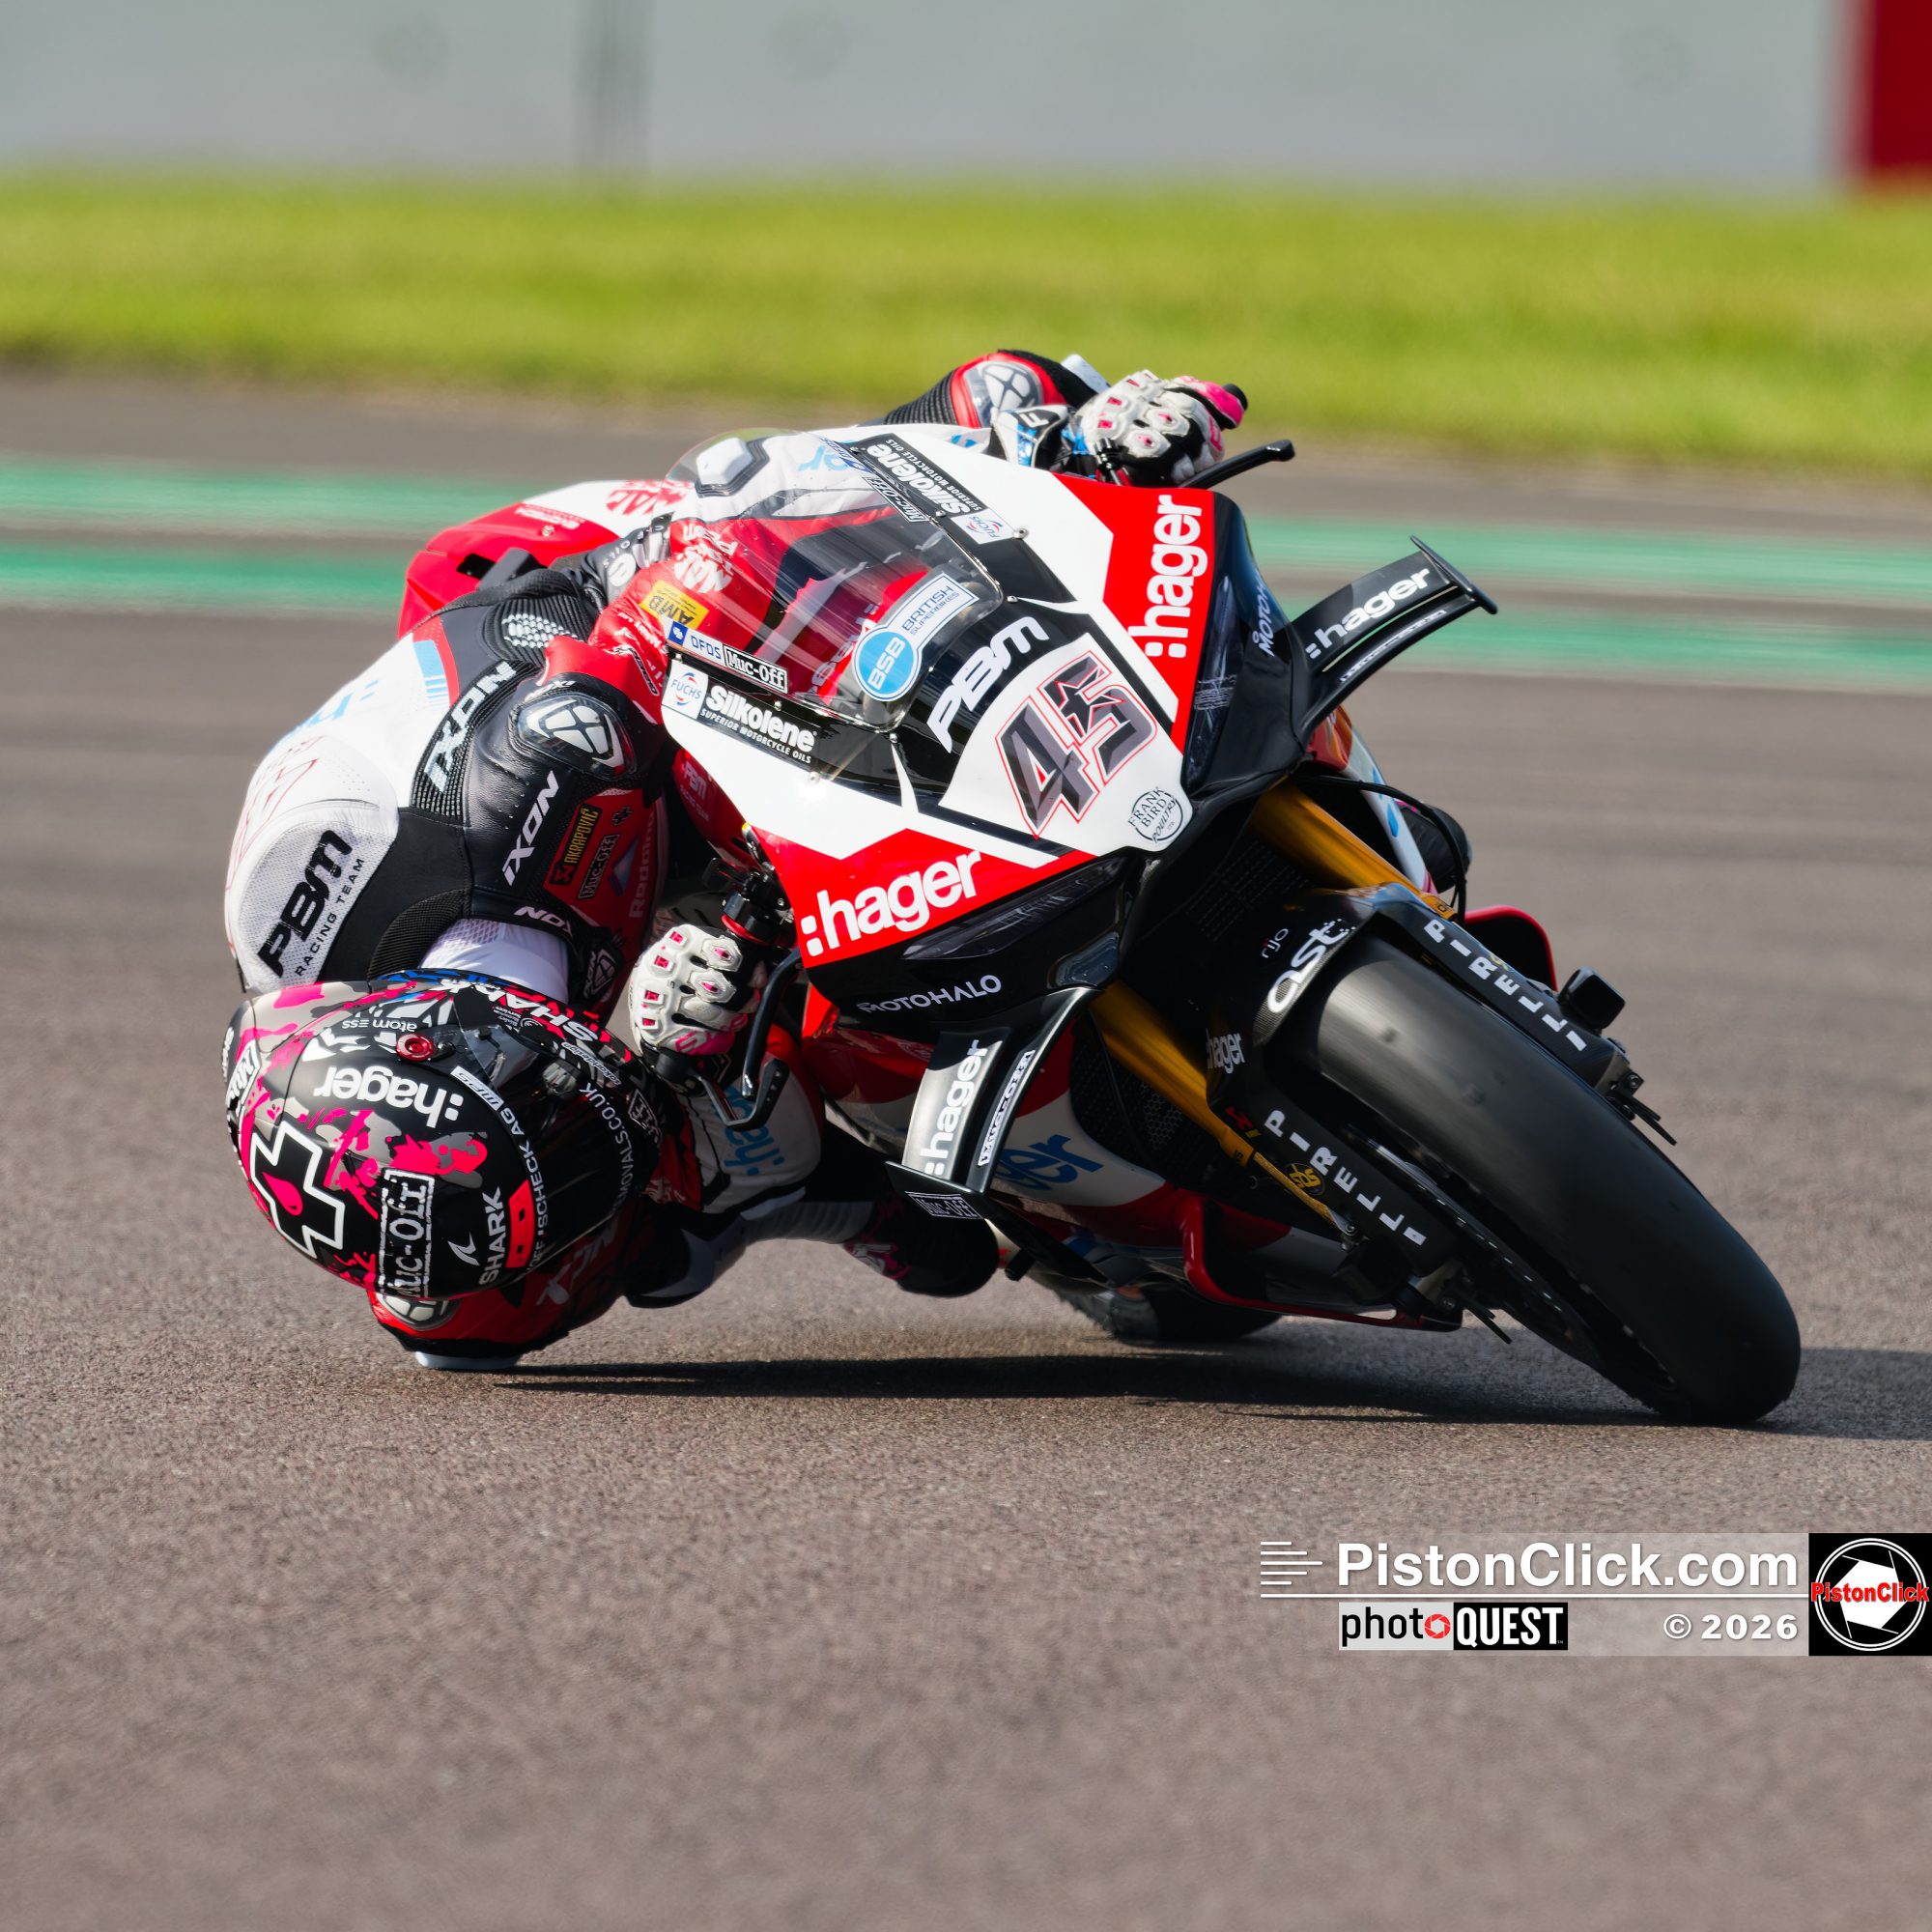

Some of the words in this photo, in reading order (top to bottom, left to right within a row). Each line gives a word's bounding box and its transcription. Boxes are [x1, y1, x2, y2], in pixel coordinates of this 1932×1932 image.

[886, 439, 904, 451] OILS
[867, 443, 971, 514] Silkolene
[902, 450, 950, 486] MOTORCYCLE
[947, 485, 982, 511] SUPERIOR
[968, 516, 1000, 538] FUCHS
[902, 585, 954, 631] BRITISH
[910, 592, 959, 635] SUPERBIKES
[691, 635, 722, 660] DFDS
[728, 650, 784, 688] Muc-Off
[867, 637, 906, 691] BSB
[670, 678, 702, 699] FUCHS
[424, 662, 517, 795] IXON
[700, 708, 739, 731] SUPERIOR
[739, 726, 790, 755] MOTORCYCLE
[793, 749, 811, 764] OILS
[705, 685, 816, 753] Silkolene
[995, 650, 1157, 839] 45
[1128, 786, 1160, 826] FRANK
[1141, 799, 1167, 827] BIRD
[502, 770, 559, 887] IXON
[295, 913, 337, 976] RACING
[336, 858, 365, 904] TEAM
[857, 974, 1002, 1013] MOTOHALO
[1424, 919, 1587, 1051] PIRELLI
[373, 1019, 417, 1032] atom
[500, 1107, 525, 1135] AG
[580, 1083, 637, 1209] MOVALS.CO.UK
[1264, 1110, 1427, 1245] PIRELLI
[479, 1185, 507, 1286] SHARK
